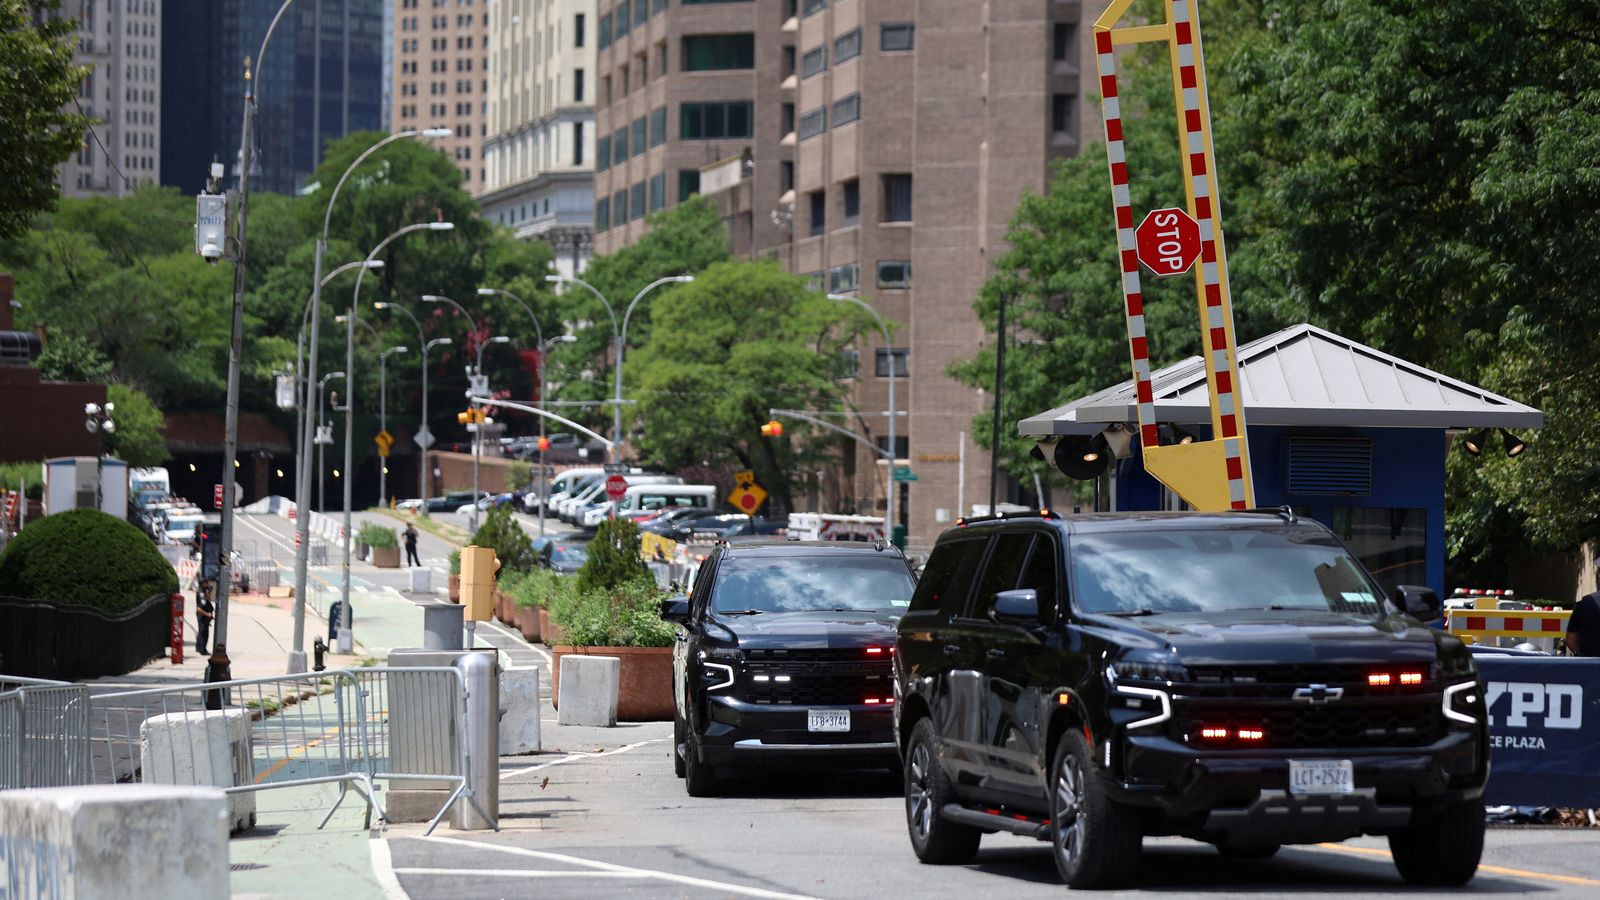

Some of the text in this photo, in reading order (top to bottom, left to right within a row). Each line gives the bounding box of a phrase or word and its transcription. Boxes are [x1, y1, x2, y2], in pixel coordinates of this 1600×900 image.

[1154, 213, 1183, 270] STOP
[1484, 681, 1583, 729] YPD
[1505, 736, 1545, 749] PLAZA
